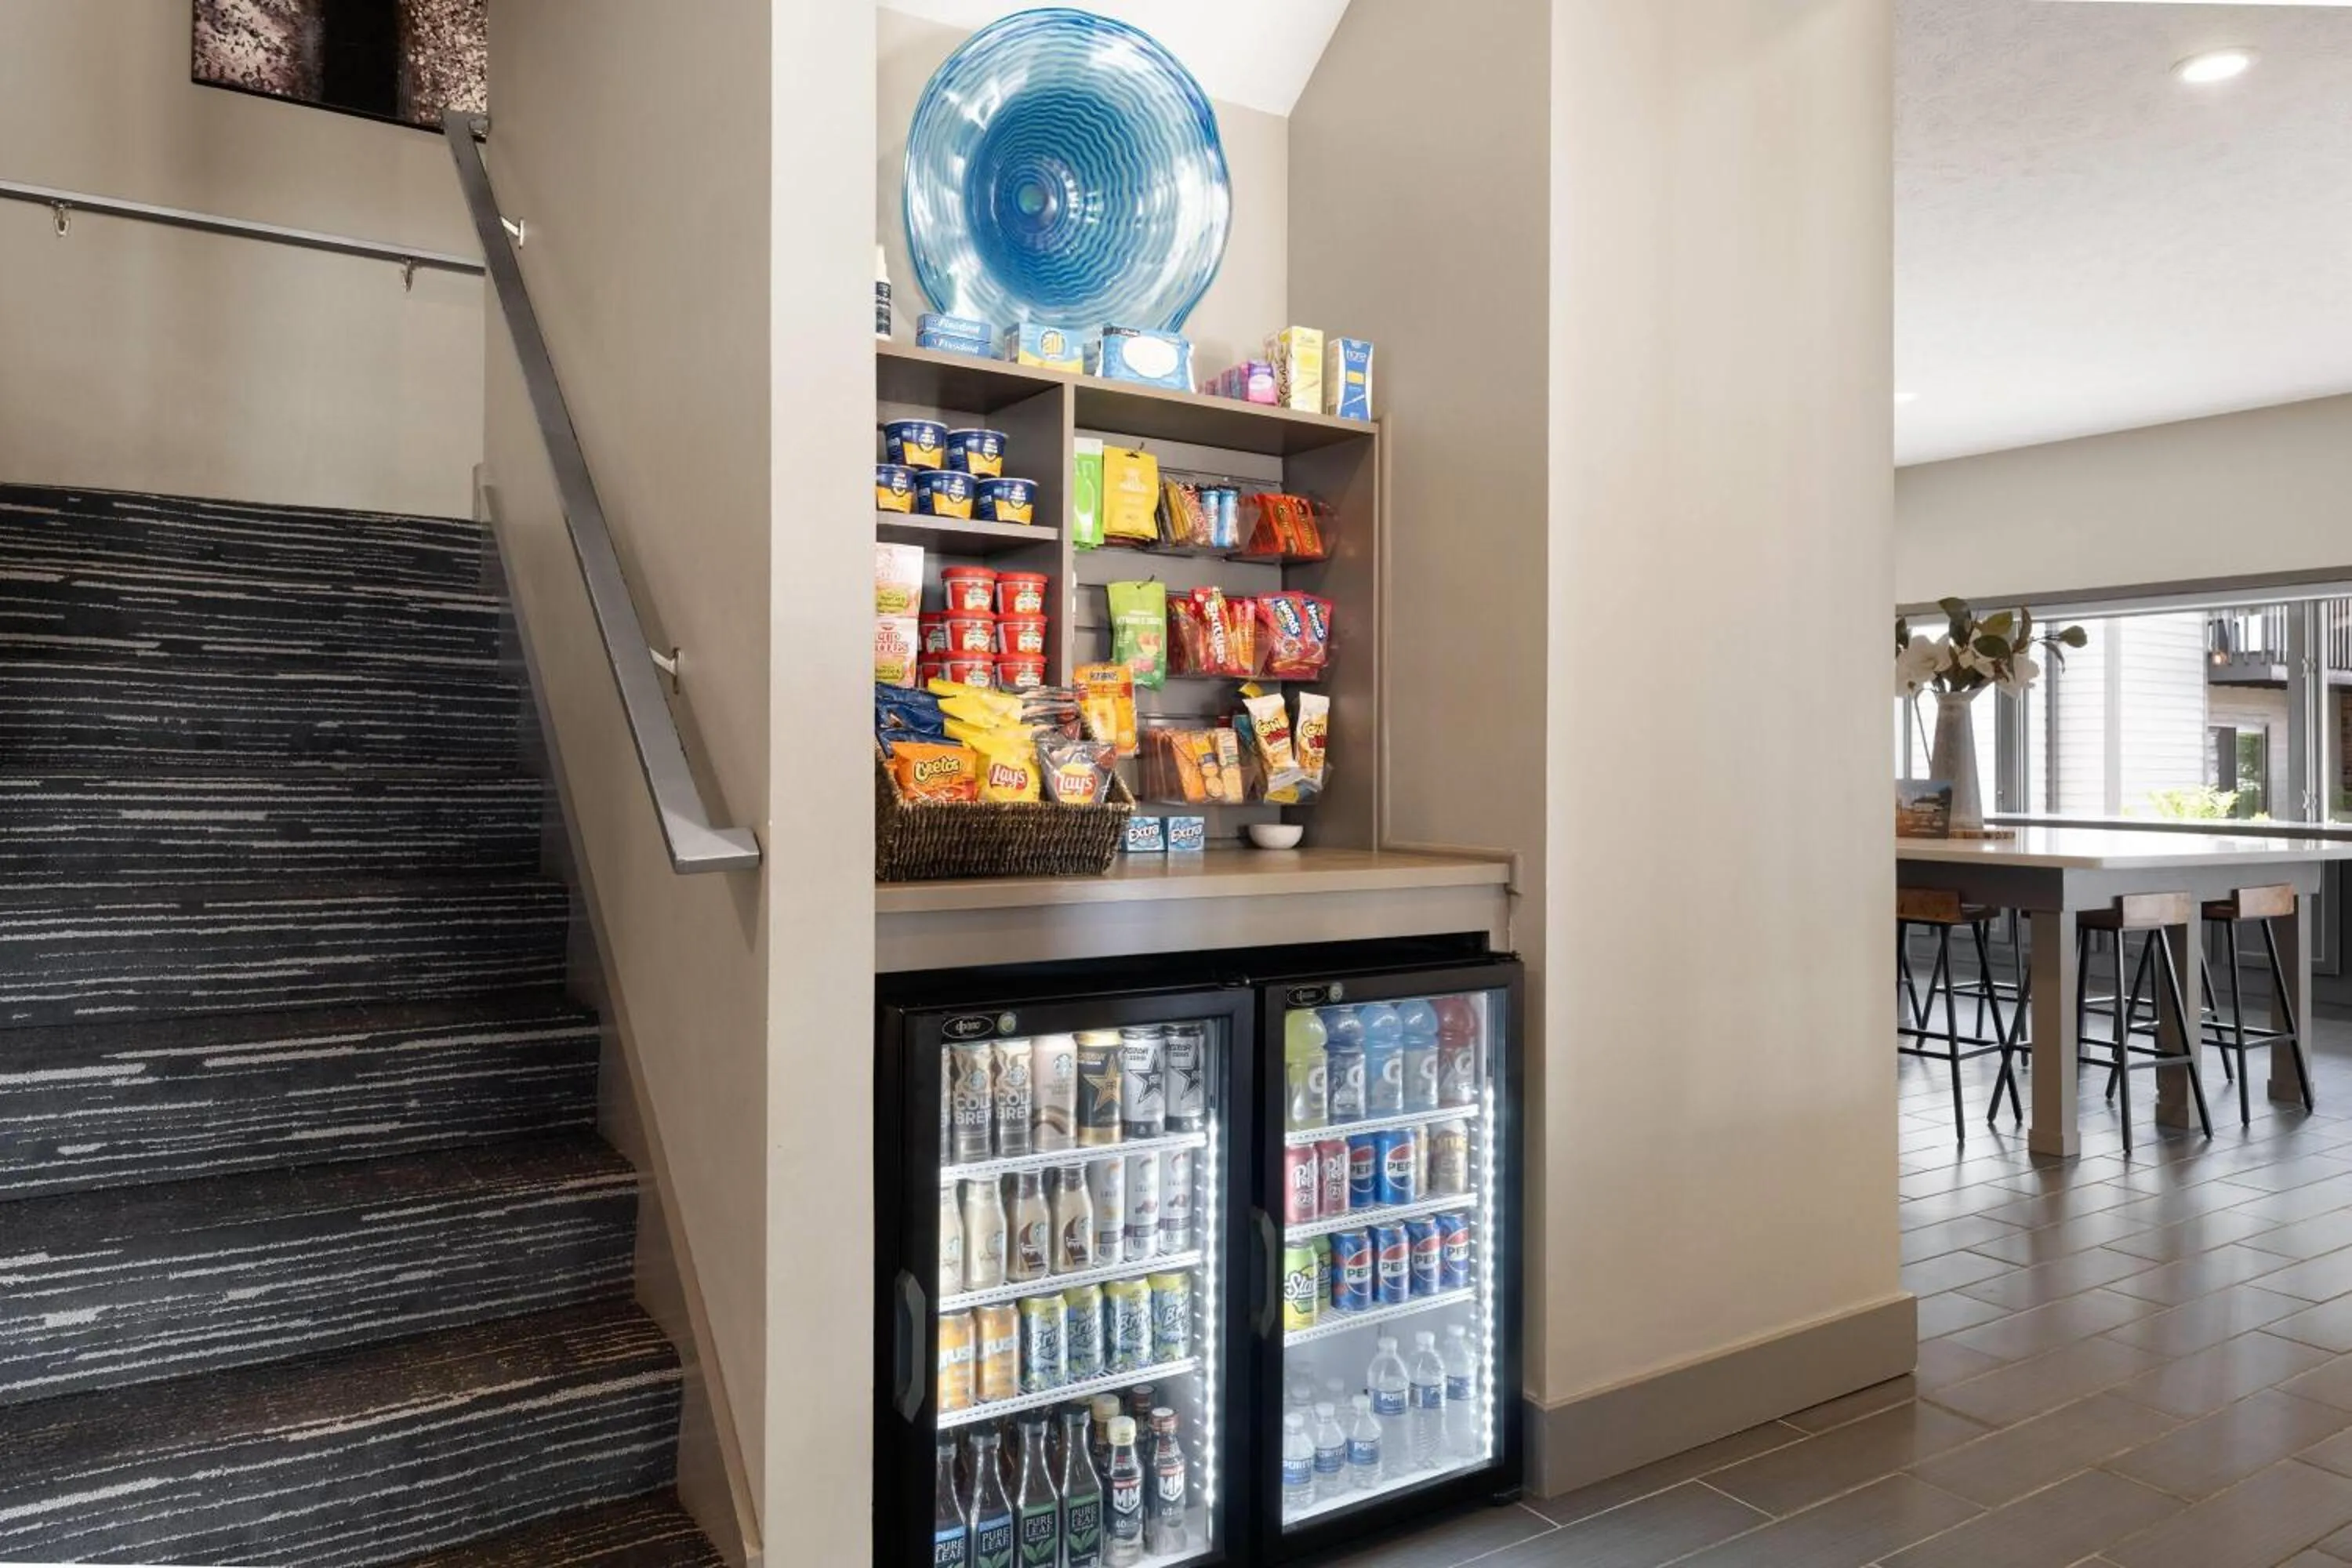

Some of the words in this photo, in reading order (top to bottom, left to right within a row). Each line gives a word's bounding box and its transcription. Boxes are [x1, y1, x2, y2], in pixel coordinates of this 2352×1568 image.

[1129, 824, 1159, 844] Extra
[1171, 824, 1202, 844] Extra
[1026, 1513, 1053, 1526] PURE
[982, 1527, 1010, 1541] PURE
[936, 1538, 965, 1552] PURE
